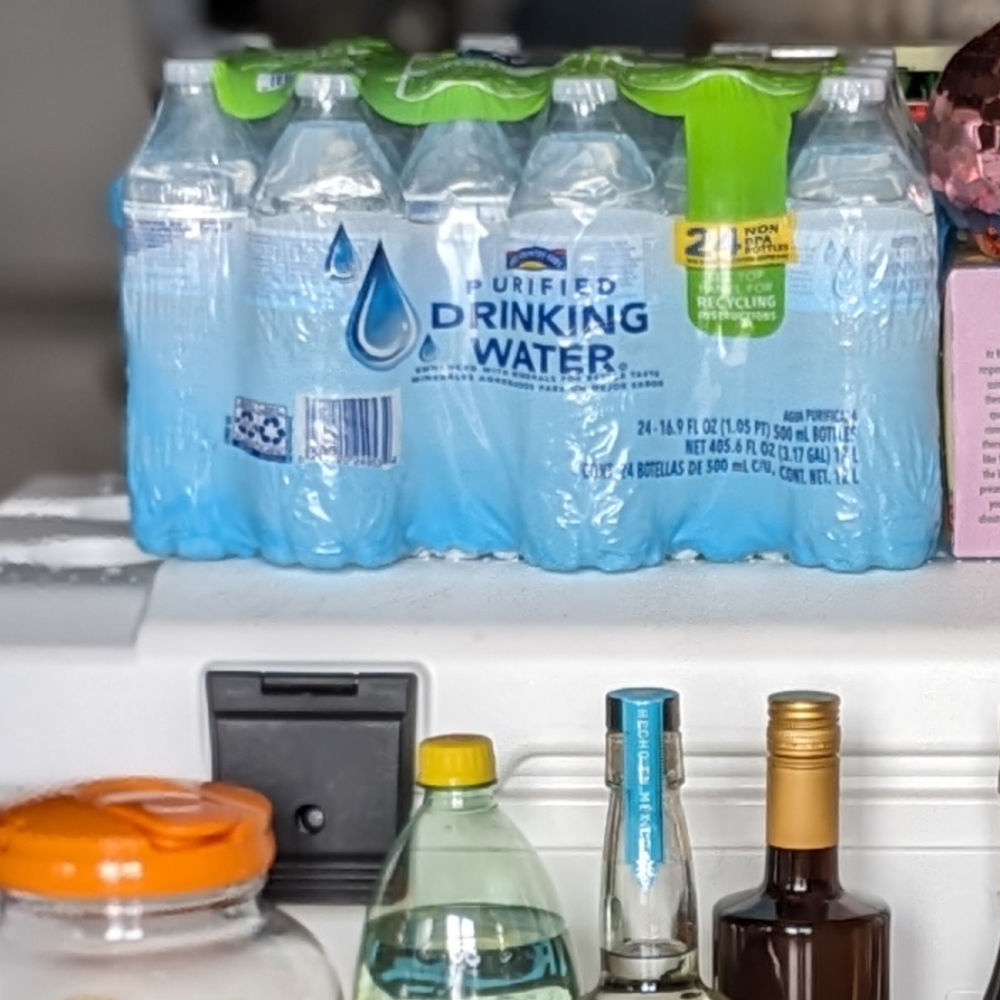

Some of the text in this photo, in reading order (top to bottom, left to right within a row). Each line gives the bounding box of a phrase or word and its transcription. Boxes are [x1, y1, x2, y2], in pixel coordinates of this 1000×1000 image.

[466, 277, 616, 296] PURIFIED
[431, 301, 648, 337] DRINKING
[471, 338, 616, 374] WATER
[688, 421, 698, 435] FL
[703, 421, 717, 435] OZ
[773, 426, 792, 440] 500
[686, 439, 705, 454] NET
[709, 440, 742, 454] 405.6
[637, 461, 684, 478] BOTELLAS
[688, 461, 703, 475] DE
[706, 459, 728, 474] 500
